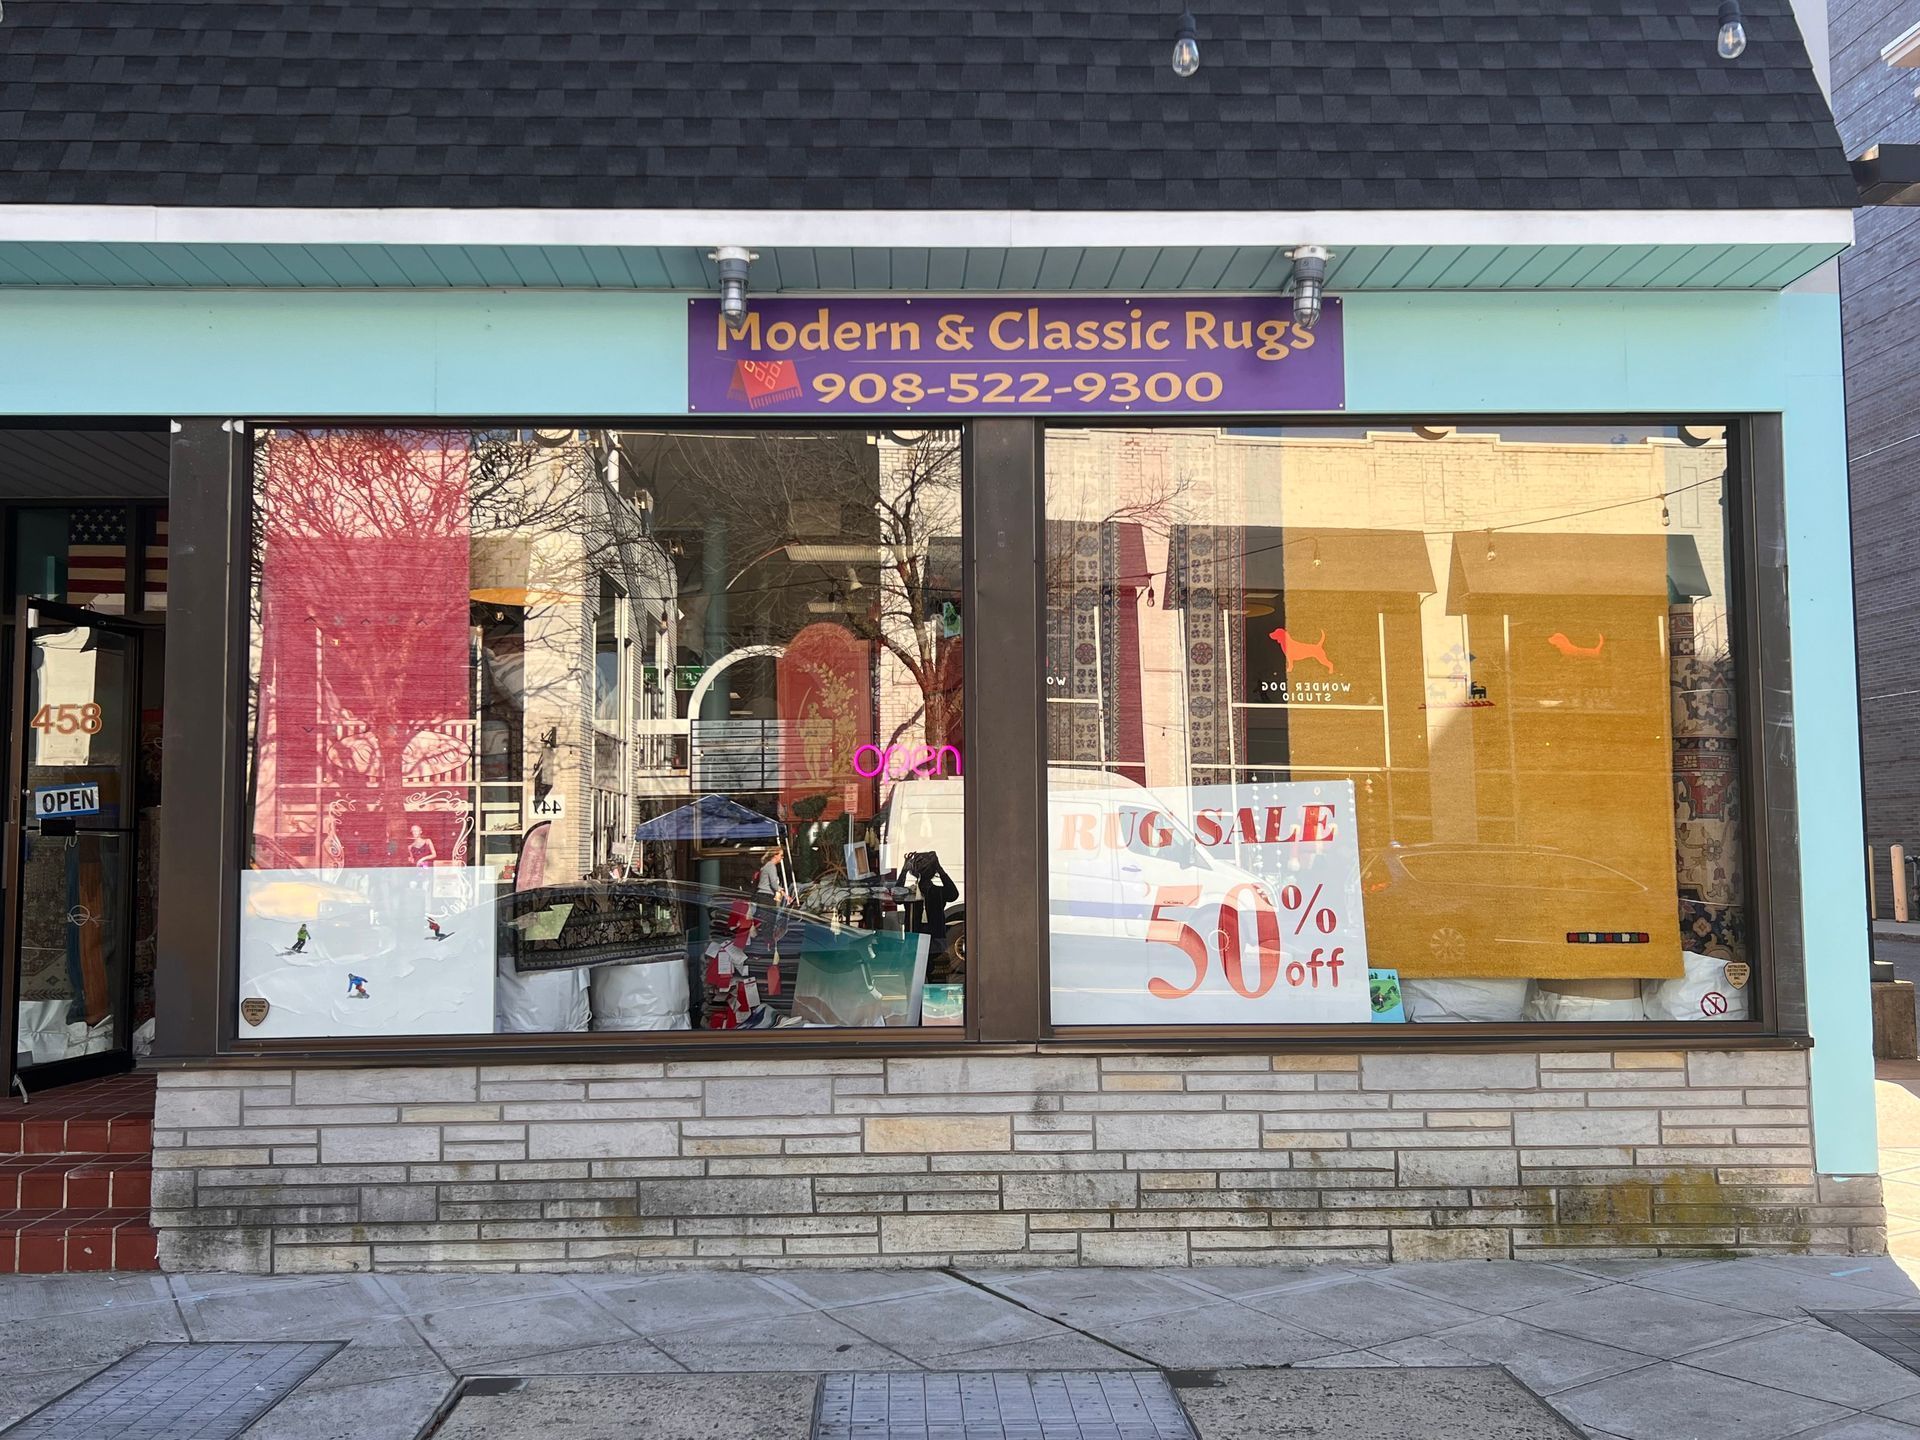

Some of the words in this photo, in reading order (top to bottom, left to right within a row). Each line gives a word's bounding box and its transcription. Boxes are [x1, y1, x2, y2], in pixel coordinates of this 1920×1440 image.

[717, 308, 921, 351] Modern
[935, 314, 974, 351] &
[988, 307, 1171, 351] Classic
[1184, 311, 1315, 361] Rugs
[812, 372, 1223, 404] 908-522-9300
[31, 703, 102, 735] 458
[854, 743, 962, 784] open
[42, 789, 95, 812] OPEN
[1059, 810, 1175, 852] RUG
[1194, 804, 1336, 846] SALE
[1285, 947, 1345, 988] off
